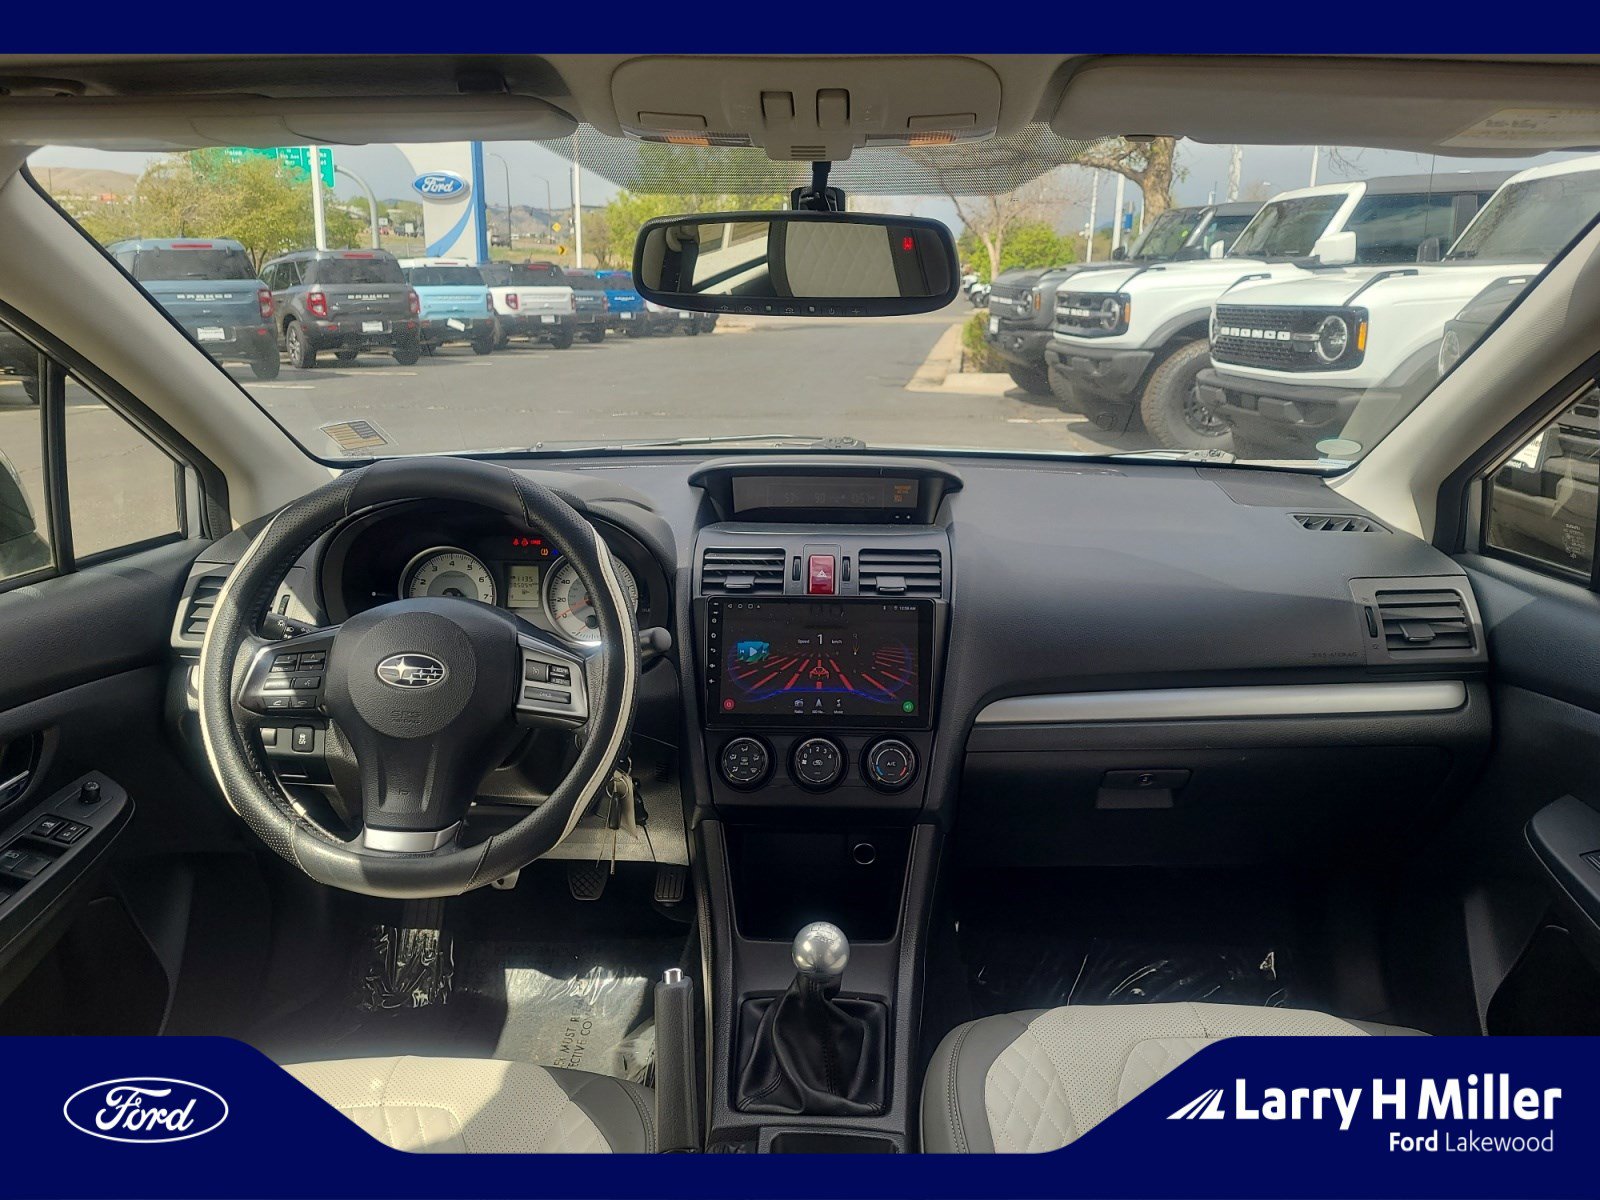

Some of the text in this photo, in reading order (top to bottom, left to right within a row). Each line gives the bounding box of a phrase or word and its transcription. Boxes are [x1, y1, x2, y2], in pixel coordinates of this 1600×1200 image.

[421, 177, 455, 193] Ford
[1220, 326, 1291, 341] BRONCO
[467, 563, 473, 571] 5
[817, 634, 824, 645] 1
[560, 1027, 577, 1053] MUST
